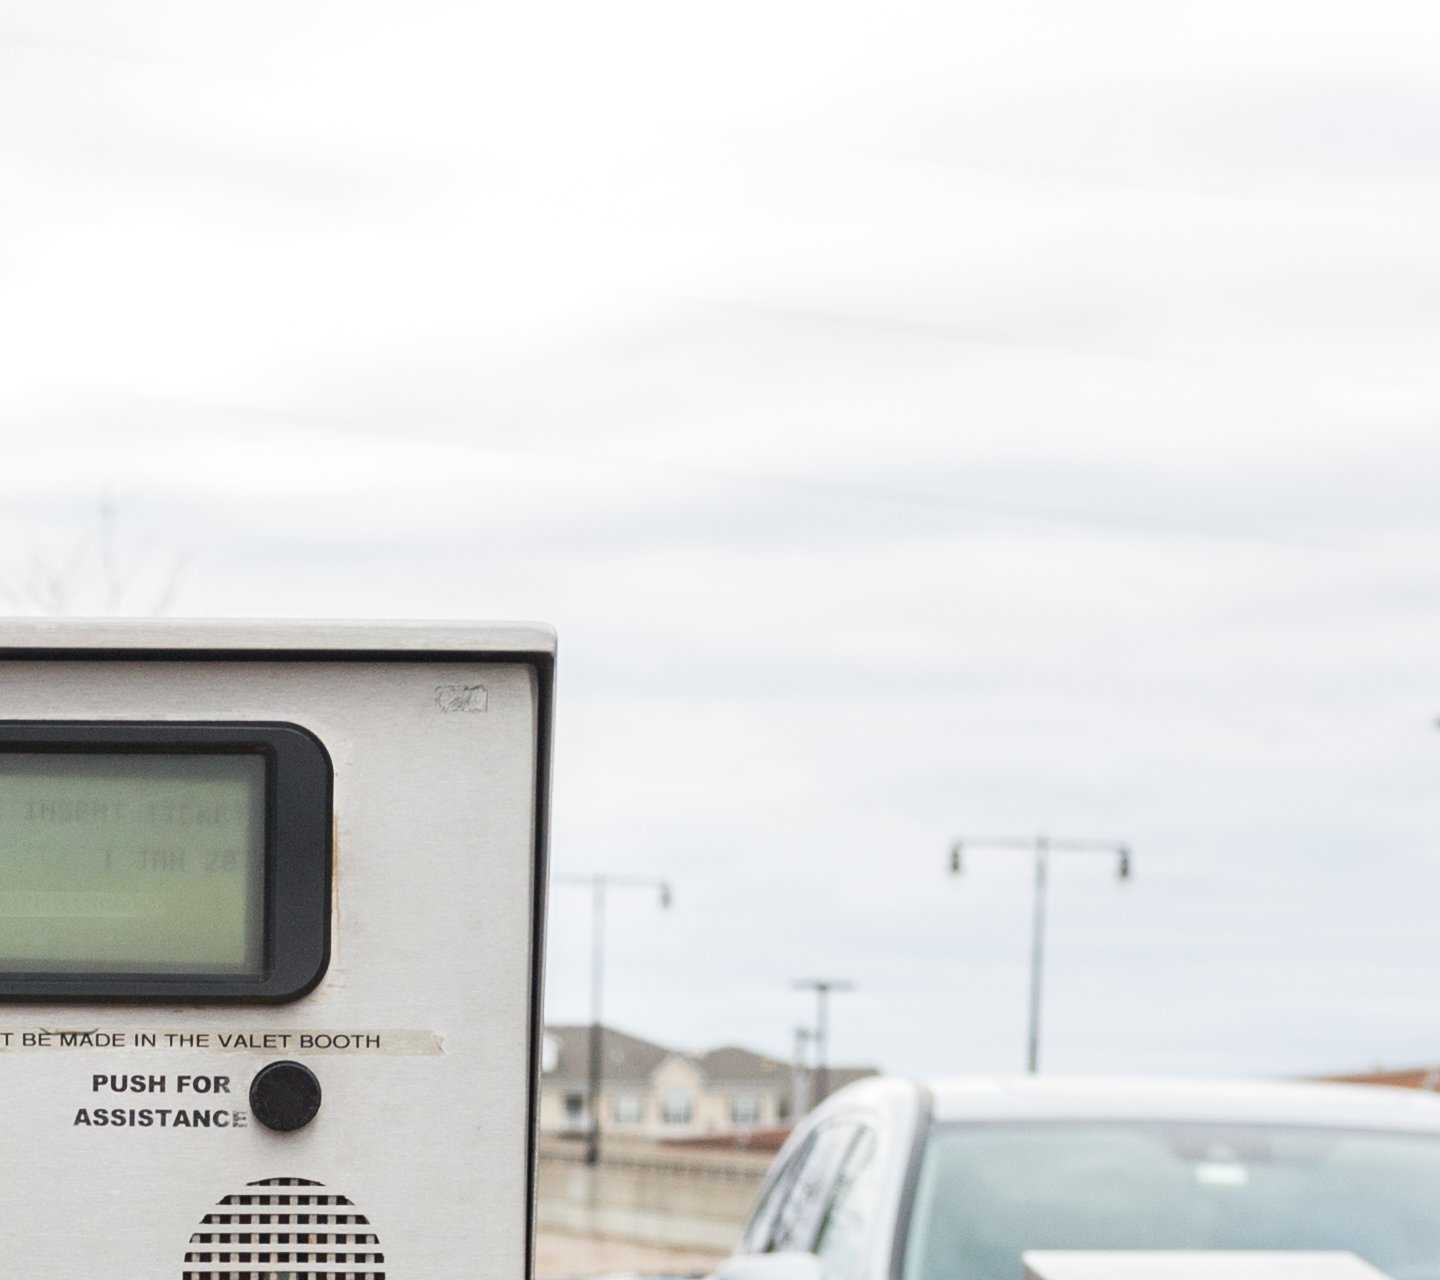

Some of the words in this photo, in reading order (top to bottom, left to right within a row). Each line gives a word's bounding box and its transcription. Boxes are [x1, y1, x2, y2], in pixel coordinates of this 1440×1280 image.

[22, 1032, 51, 1047] BE
[59, 1032, 126, 1048] MADE
[134, 1033, 156, 1048] IN
[164, 1033, 210, 1048] THE
[218, 1033, 293, 1049] VALET
[300, 1033, 381, 1050] BOOTH
[92, 1074, 166, 1093] PUSH
[176, 1074, 231, 1094] FOR
[73, 1108, 249, 1128] ASSISTANCE
